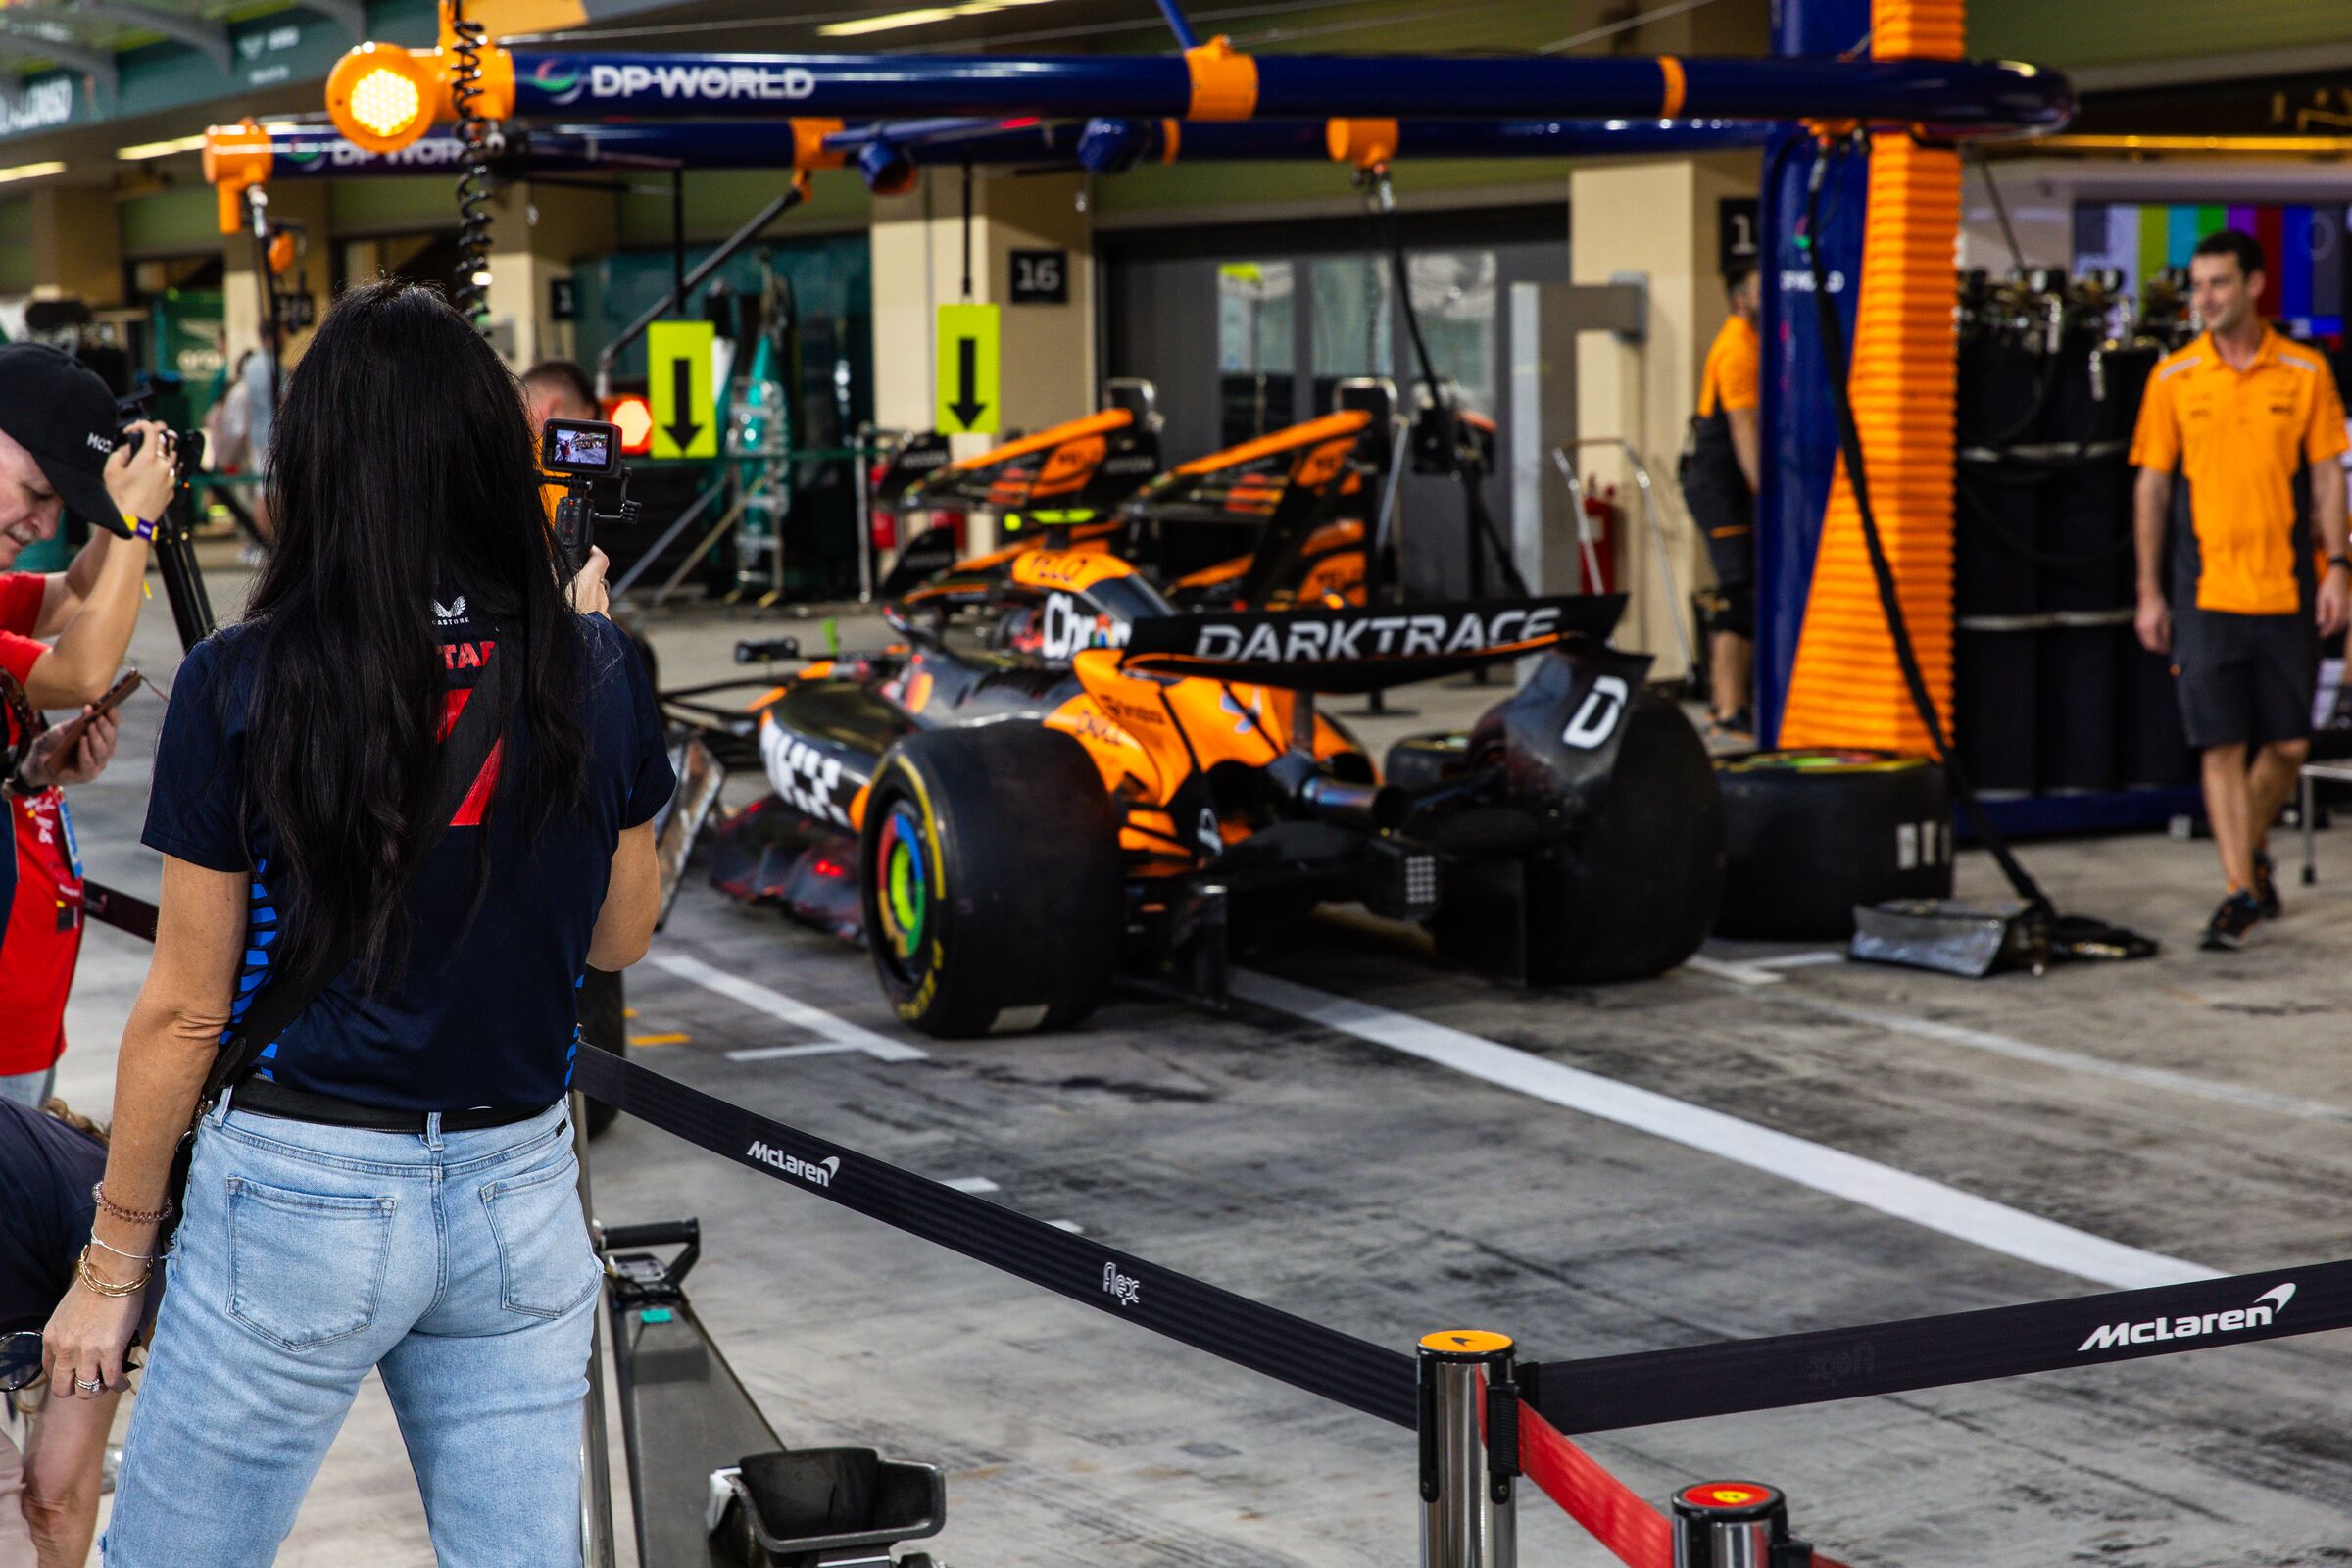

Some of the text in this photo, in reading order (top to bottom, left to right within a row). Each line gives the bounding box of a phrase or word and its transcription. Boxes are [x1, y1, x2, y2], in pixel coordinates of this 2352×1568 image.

[591, 65, 815, 99] DP WORLD
[1017, 258, 1060, 292] 16
[1195, 606, 1562, 662] DARKTRACE
[746, 1140, 833, 1188] McLaren
[2076, 1304, 2274, 1352] McLaren
